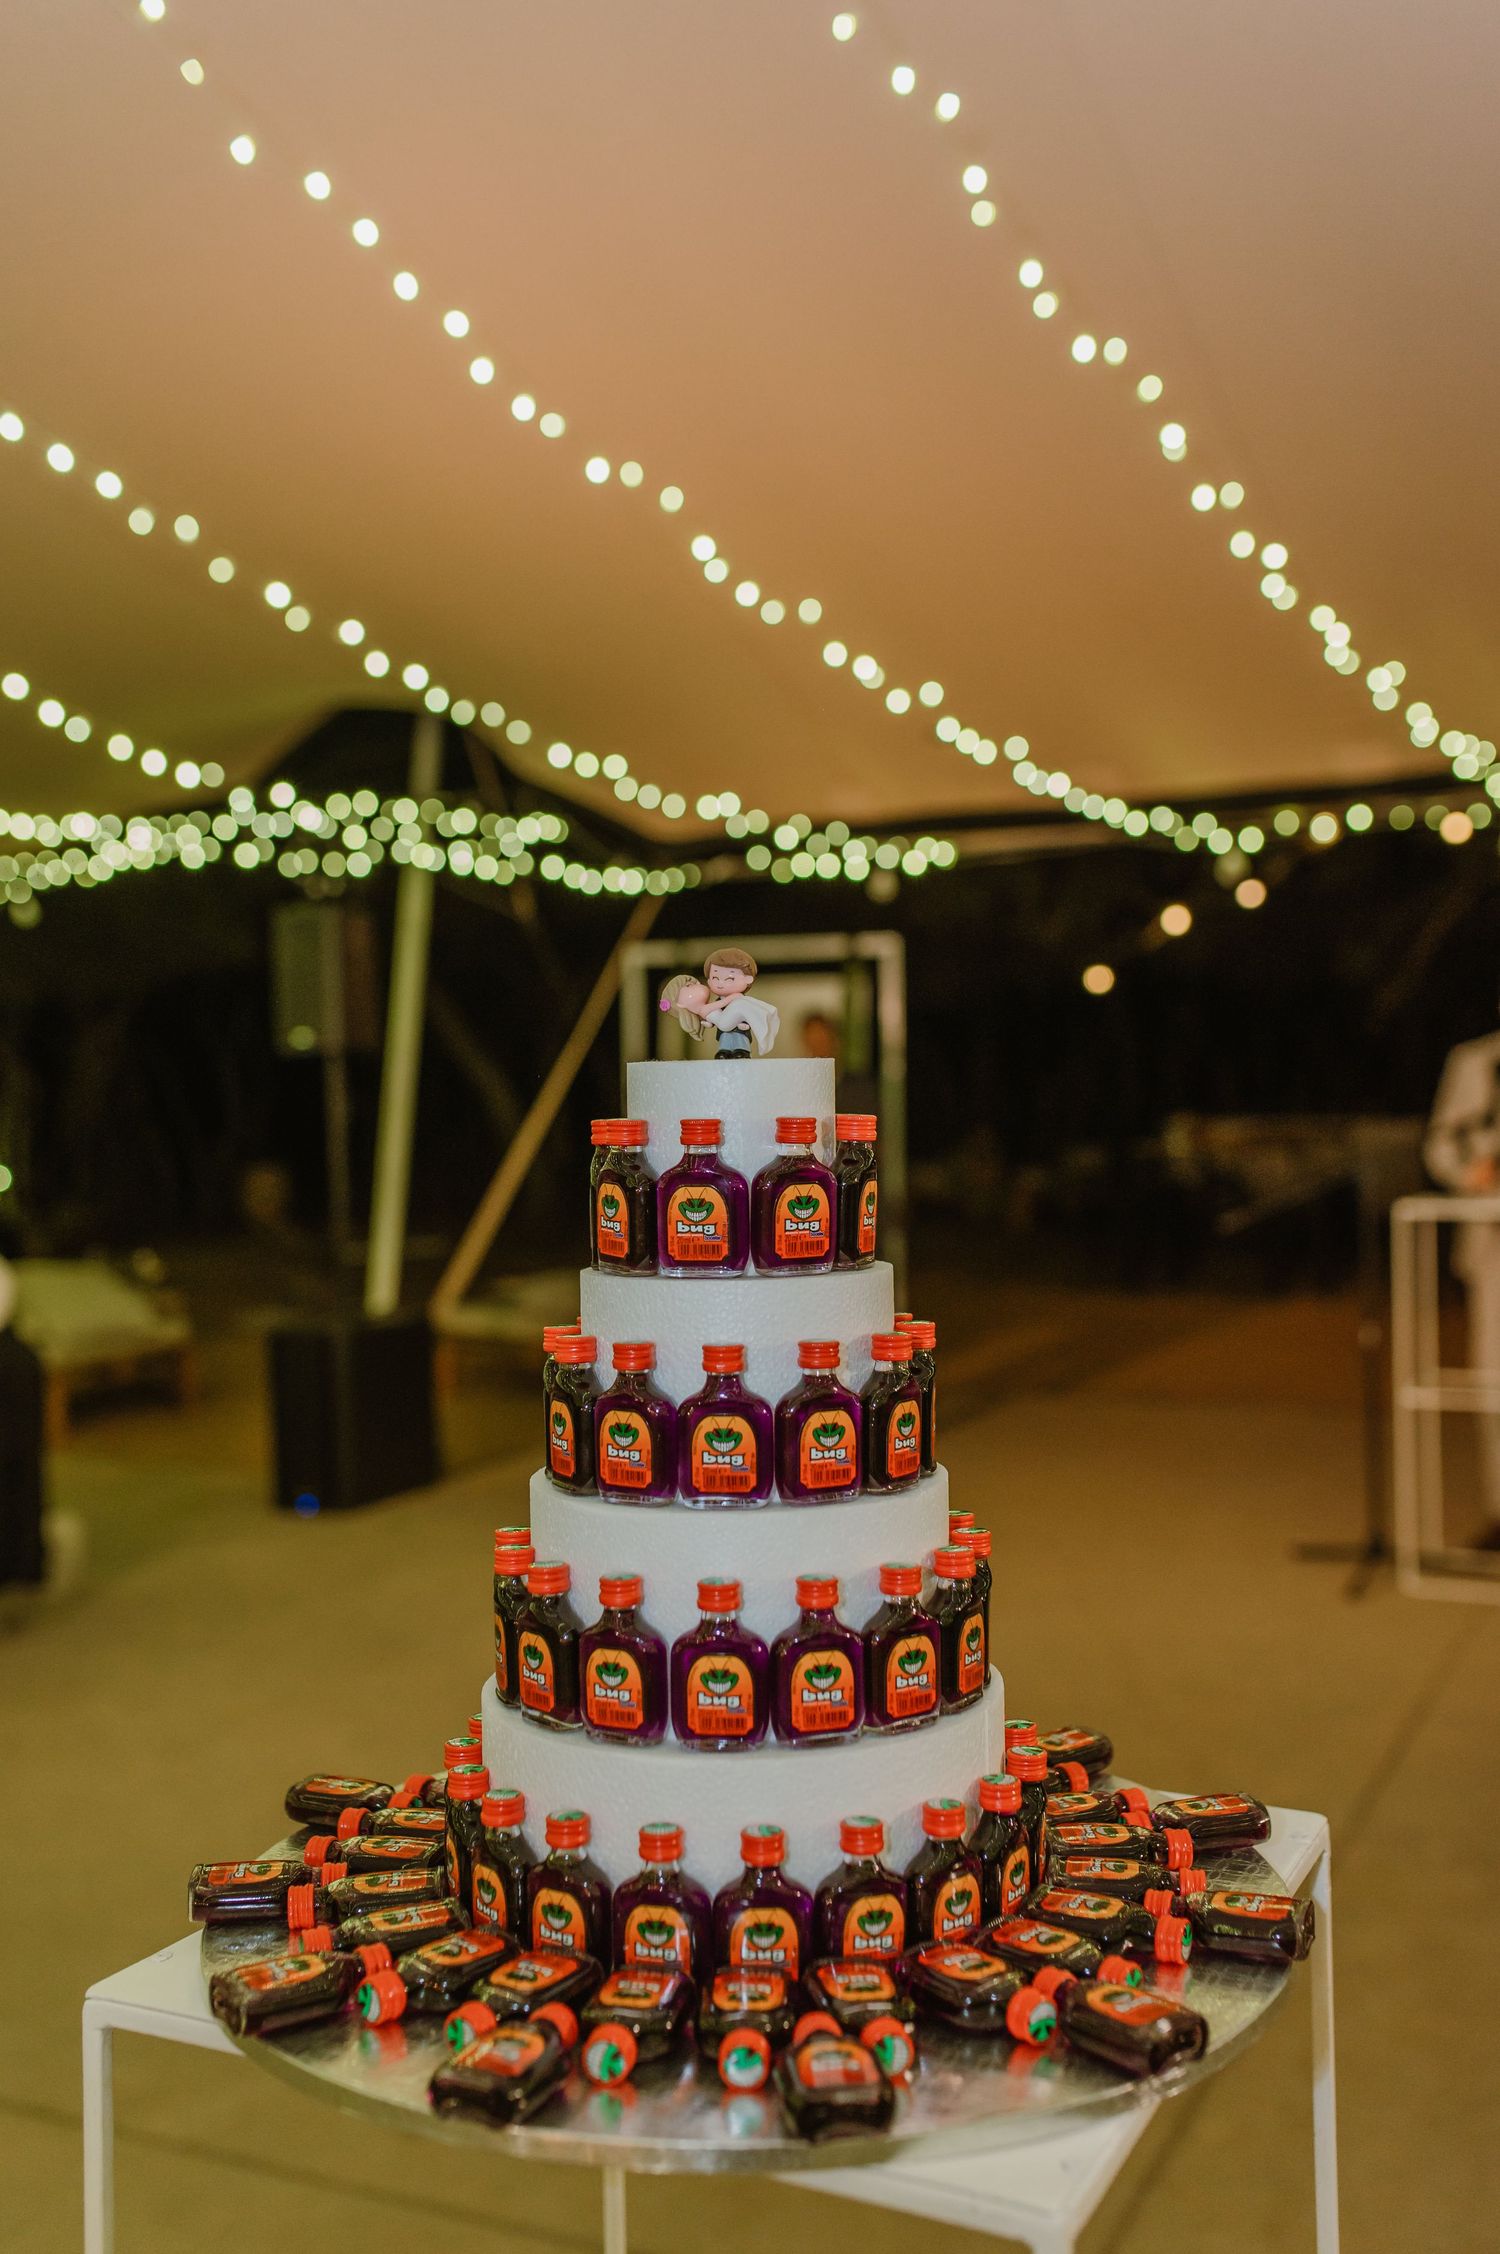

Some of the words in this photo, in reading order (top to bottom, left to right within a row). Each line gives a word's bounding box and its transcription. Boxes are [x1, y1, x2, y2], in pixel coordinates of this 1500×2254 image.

[601, 1216, 621, 1232] bug
[677, 1222, 716, 1235] bug
[785, 1219, 820, 1231] bug
[552, 1433, 568, 1451] bug
[895, 1437, 916, 1450] bug
[607, 1444, 641, 1462] bug
[702, 1451, 744, 1466] bug
[810, 1447, 846, 1460] bug
[965, 1650, 982, 1666] bug
[523, 1665, 545, 1685] bug
[896, 1673, 928, 1689] bug
[594, 1683, 631, 1702] bug
[698, 1691, 740, 1709] bug
[802, 1688, 842, 1702] bug
[1008, 1886, 1026, 1902] bug
[476, 1898, 498, 1921] bug
[943, 1913, 973, 1932] bug
[540, 1923, 574, 1946] bug
[854, 1935, 893, 1949] bug
[635, 1941, 677, 1962] bug
